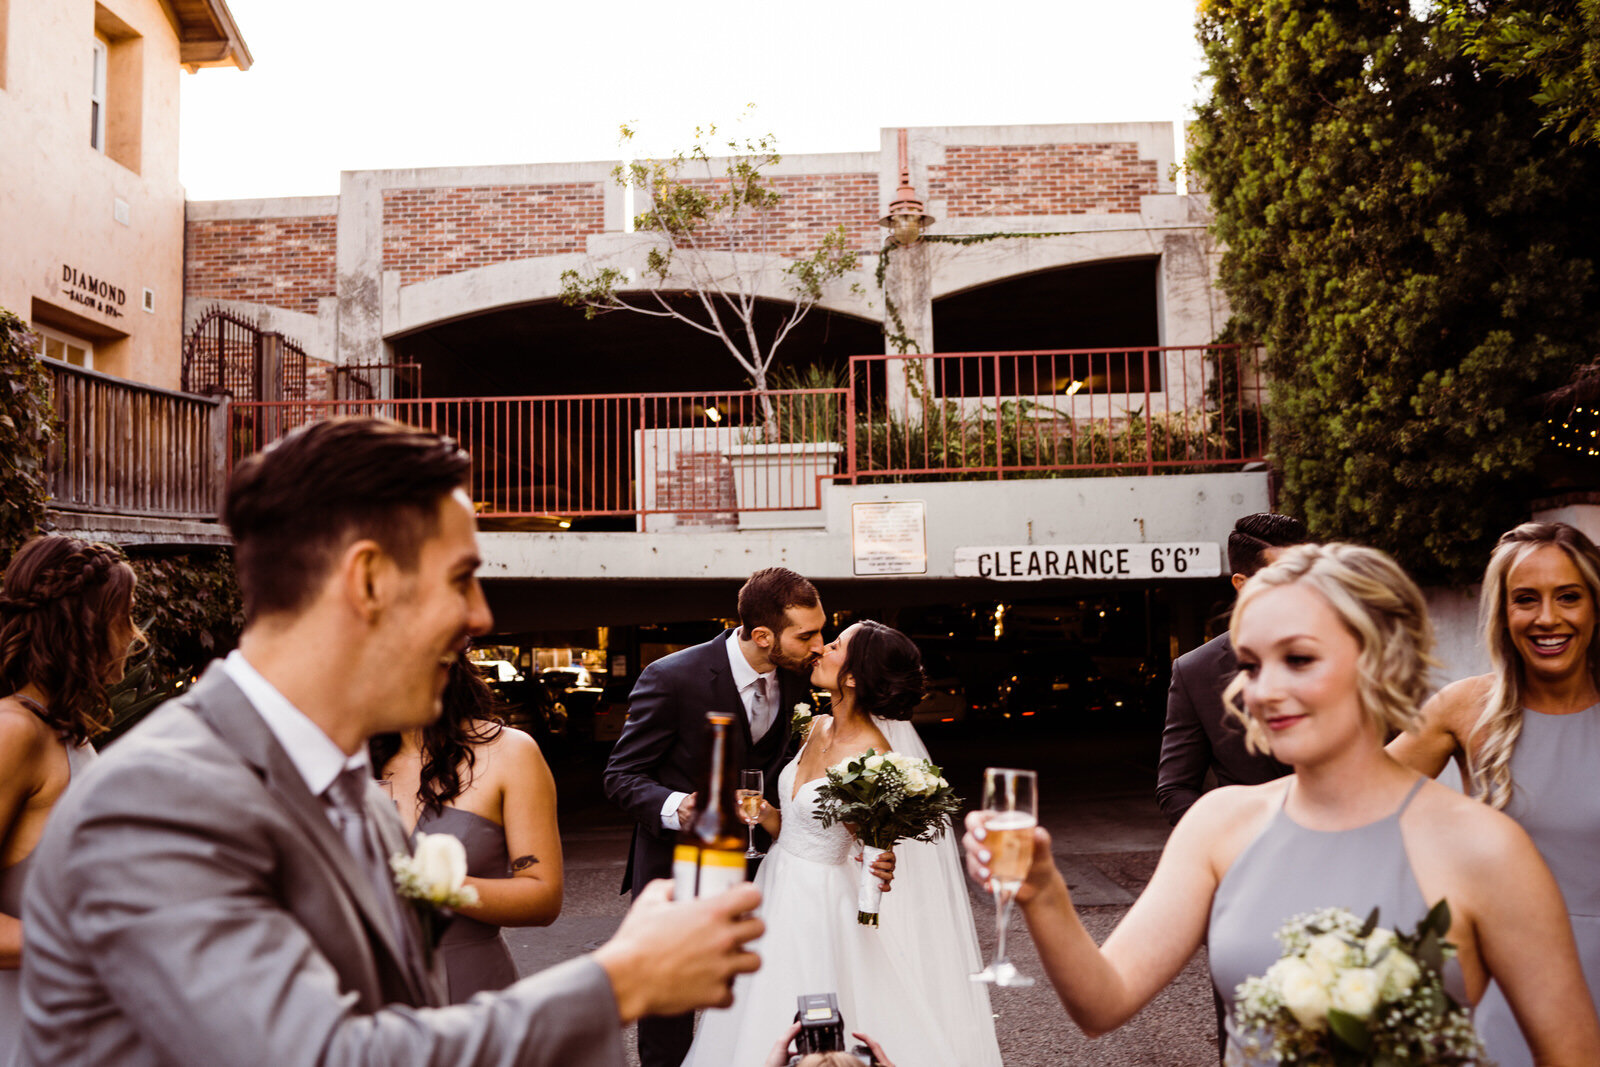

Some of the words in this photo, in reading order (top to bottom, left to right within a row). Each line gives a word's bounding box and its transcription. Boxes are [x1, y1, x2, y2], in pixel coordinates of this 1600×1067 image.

[63, 264, 125, 305] DIAMOND
[70, 289, 95, 308] SALON
[98, 301, 103, 312] &
[105, 304, 118, 318] SPA
[978, 548, 1130, 577] CLEARANCE
